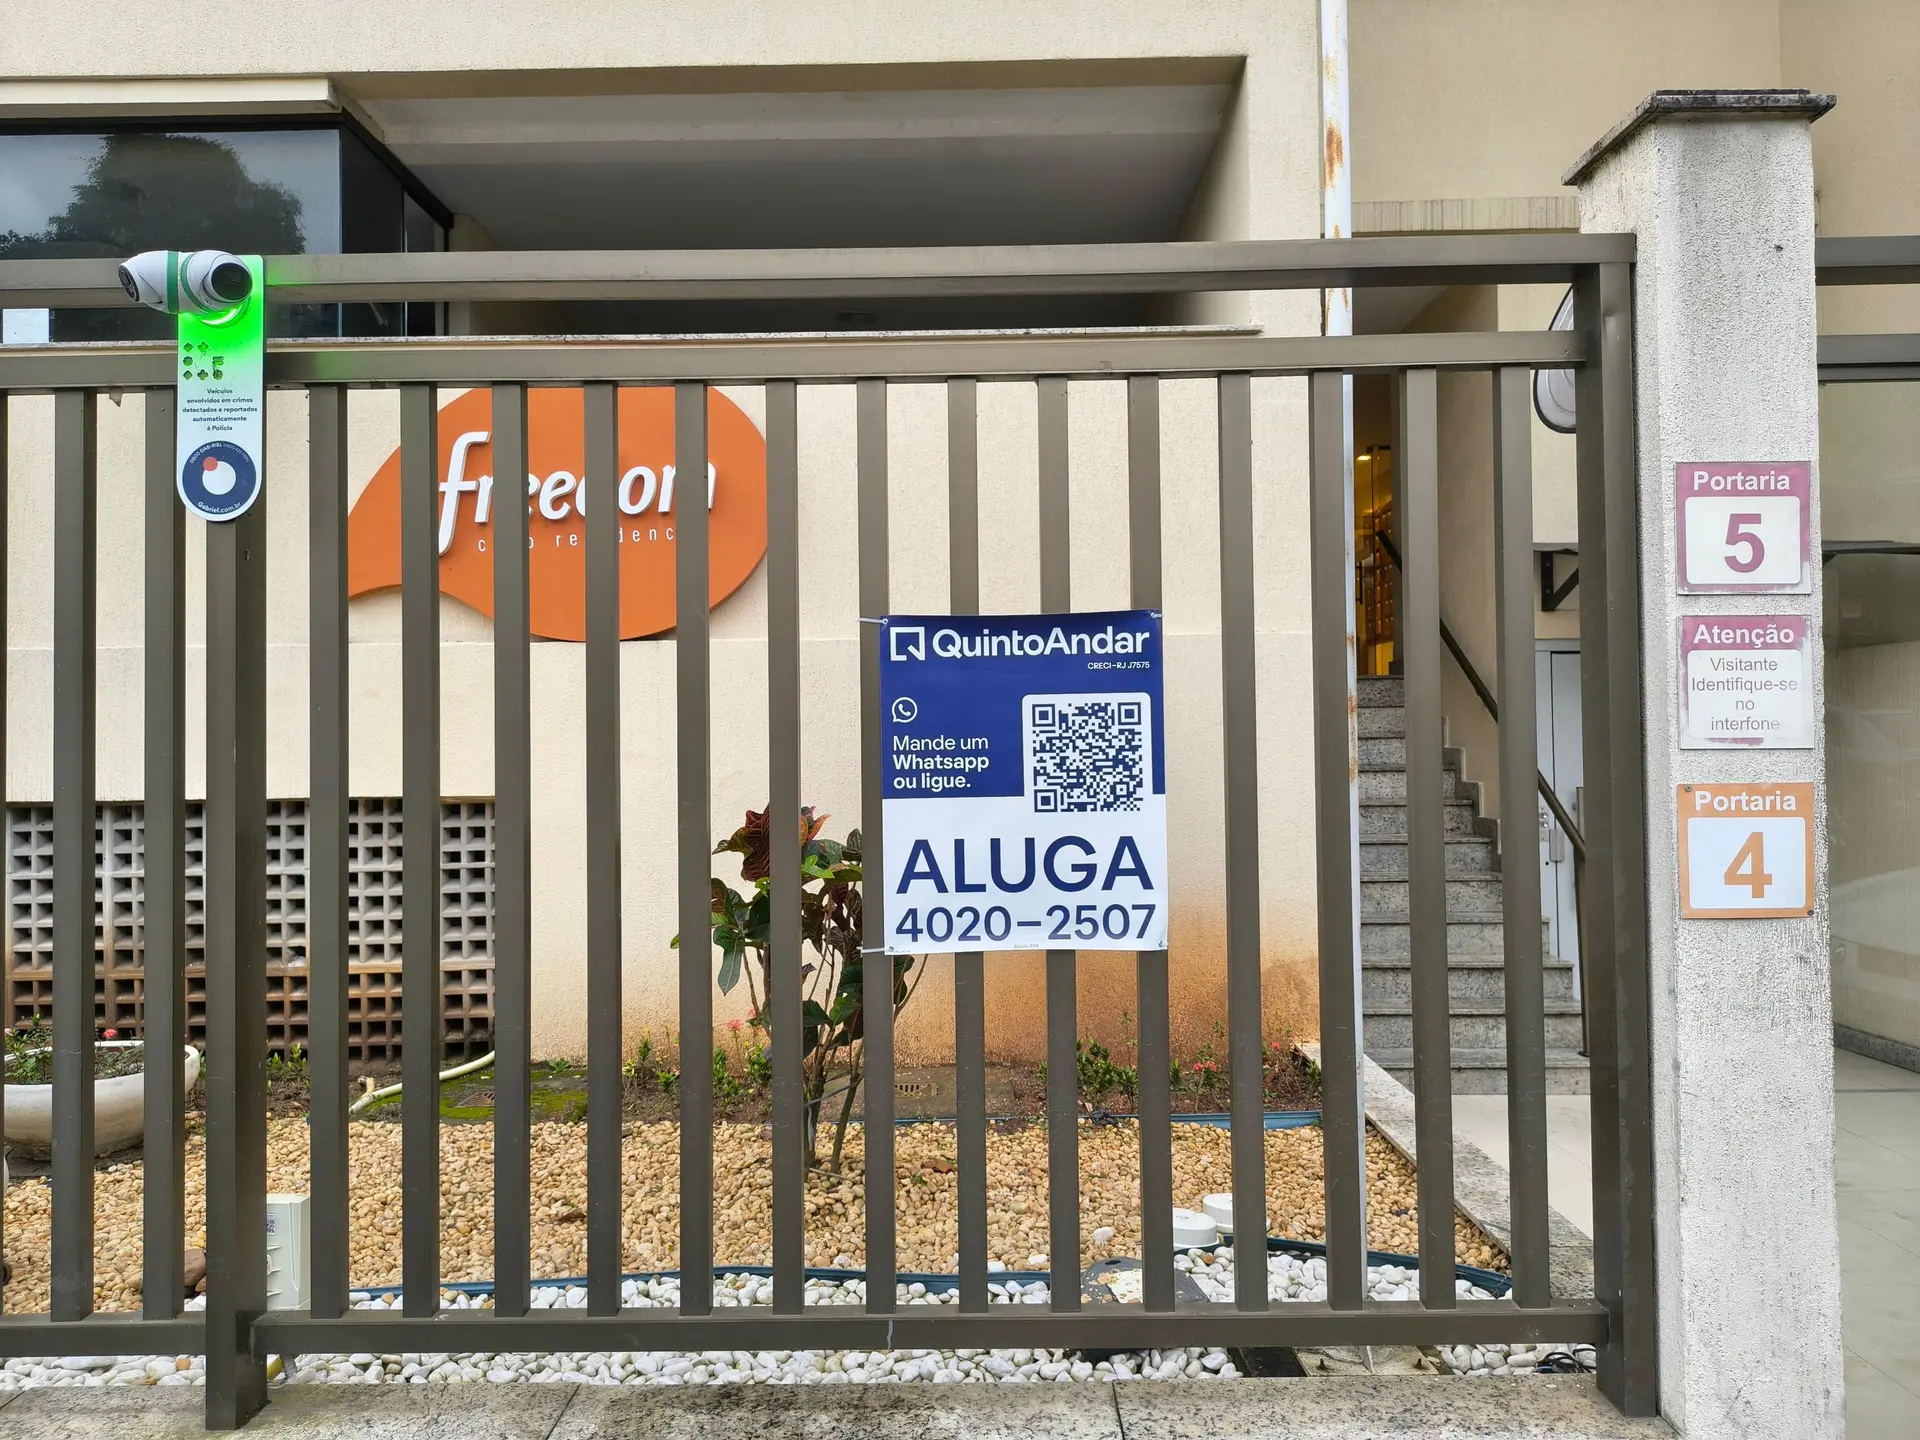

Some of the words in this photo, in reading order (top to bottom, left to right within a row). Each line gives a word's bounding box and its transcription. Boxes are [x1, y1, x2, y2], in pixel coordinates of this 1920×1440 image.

[1693, 470, 1791, 491] Portaria
[197, 501, 242, 514] Gabriel.com.br
[1723, 513, 1765, 574] 5
[932, 626, 1150, 659] QuintoAndar
[1693, 623, 1795, 650] Atenção
[1087, 662, 1126, 670] CRECI-RJ
[1127, 661, 1150, 669] J7575
[1709, 657, 1778, 672] Visitante
[1691, 676, 1798, 695] Identifique-se
[1735, 699, 1755, 712] no
[1710, 716, 1780, 731] interfone
[893, 734, 956, 751] Mande
[960, 736, 989, 750] um
[893, 754, 989, 773] Whatsapp
[893, 776, 918, 789] ou
[921, 772, 971, 792] ligue.
[1694, 790, 1796, 812] Portaria
[896, 835, 1155, 894] ALUGA
[1723, 831, 1773, 899] 4
[895, 903, 1156, 942] 4020-2507
